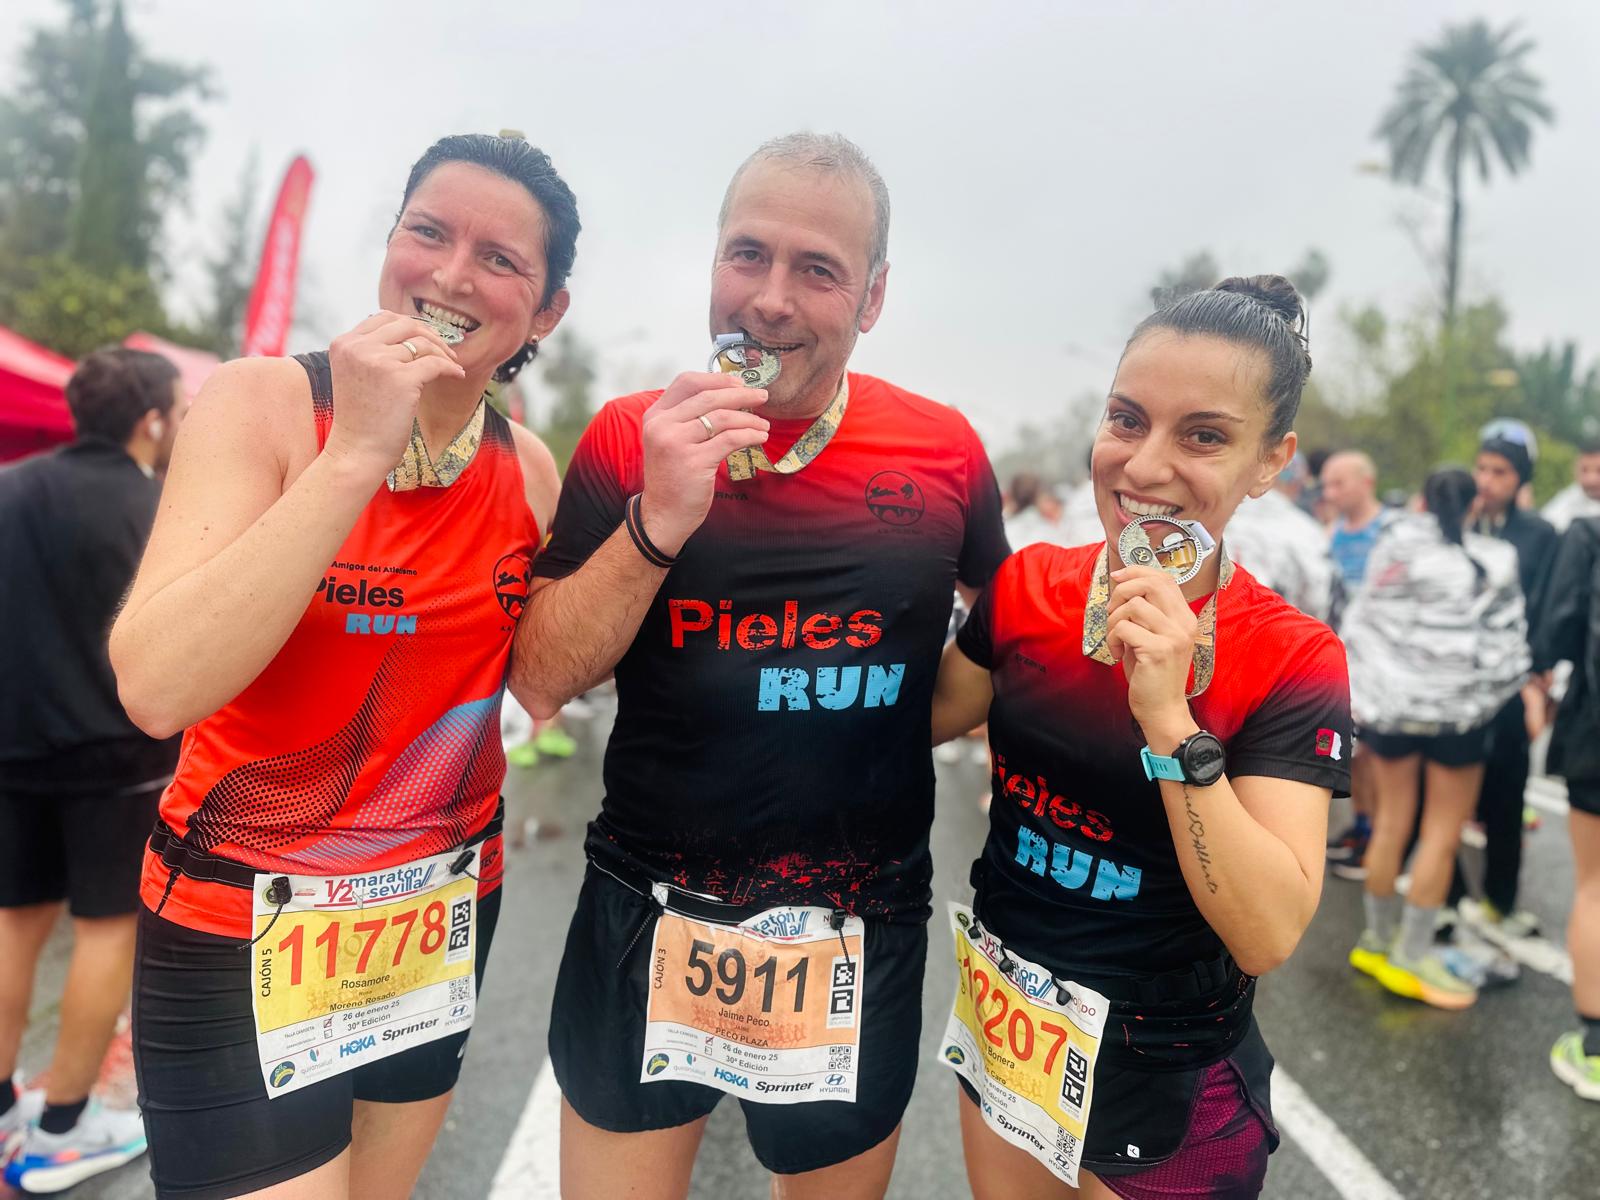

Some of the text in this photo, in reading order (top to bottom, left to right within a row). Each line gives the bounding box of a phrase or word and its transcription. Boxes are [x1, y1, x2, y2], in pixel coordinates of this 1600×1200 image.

[331, 560, 365, 572] Amigos
[368, 564, 382, 573] del
[345, 612, 418, 635] RUN
[668, 598, 884, 651] Pieles
[757, 663, 906, 712] RUN
[991, 752, 1114, 843] ieles
[1014, 825, 1143, 901] RUN
[349, 866, 423, 889] maratón
[369, 877, 424, 899] sevilla
[752, 911, 796, 932] ratón
[278, 900, 447, 986] 11778
[261, 947, 272, 997] CAJÓN 5
[654, 947, 667, 989] CAJÓN 3
[685, 938, 810, 1014] 5911
[340, 973, 391, 990] Rosamore
[329, 991, 396, 1012] Moreno Rosado
[342, 1000, 400, 1021] 26 de enero 25
[361, 1012, 391, 1028] Edición
[718, 1007, 770, 1028] Jaime Peco
[340, 1034, 376, 1058] HOKA
[382, 1017, 440, 1042] Sprinter
[715, 1027, 769, 1047] PECO PLAZA
[722, 1042, 779, 1062] 26 de enero 25
[987, 1045, 1015, 1070] Bonera
[739, 1058, 769, 1073] Edición
[991, 1069, 1007, 1085] Caro
[714, 1066, 749, 1089] HOKA
[755, 1080, 814, 1094] Sprinter
[989, 1082, 1007, 1097] enero
[1007, 1093, 1017, 1104] 25
[997, 1113, 1046, 1152] Sprinter
